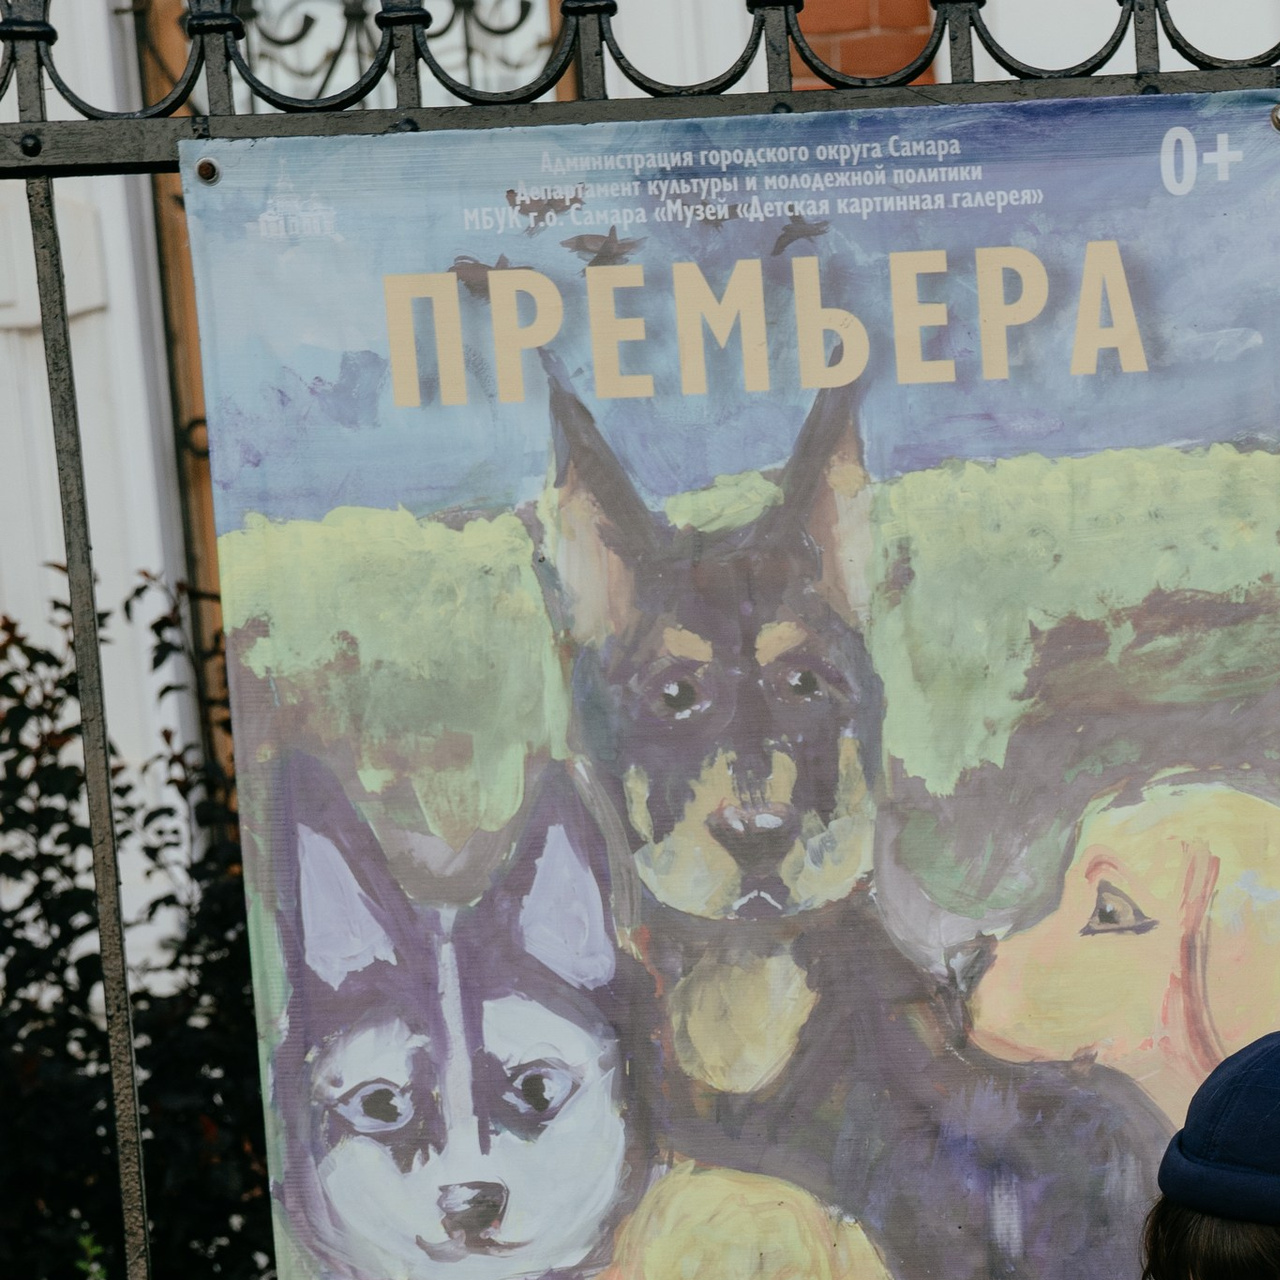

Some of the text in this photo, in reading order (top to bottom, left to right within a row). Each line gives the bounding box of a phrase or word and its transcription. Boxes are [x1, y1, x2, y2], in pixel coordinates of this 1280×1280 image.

[540, 135, 961, 176] Администрация городского округа Самара
[1160, 126, 1244, 196] 0+
[515, 164, 983, 206] Департамент культуры и молодежной политики
[463, 188, 1044, 234] МБУК г.о. Самара «Музей «Детская картинная галерея»
[383, 240, 1149, 408] ПРЕМЬЕРА
